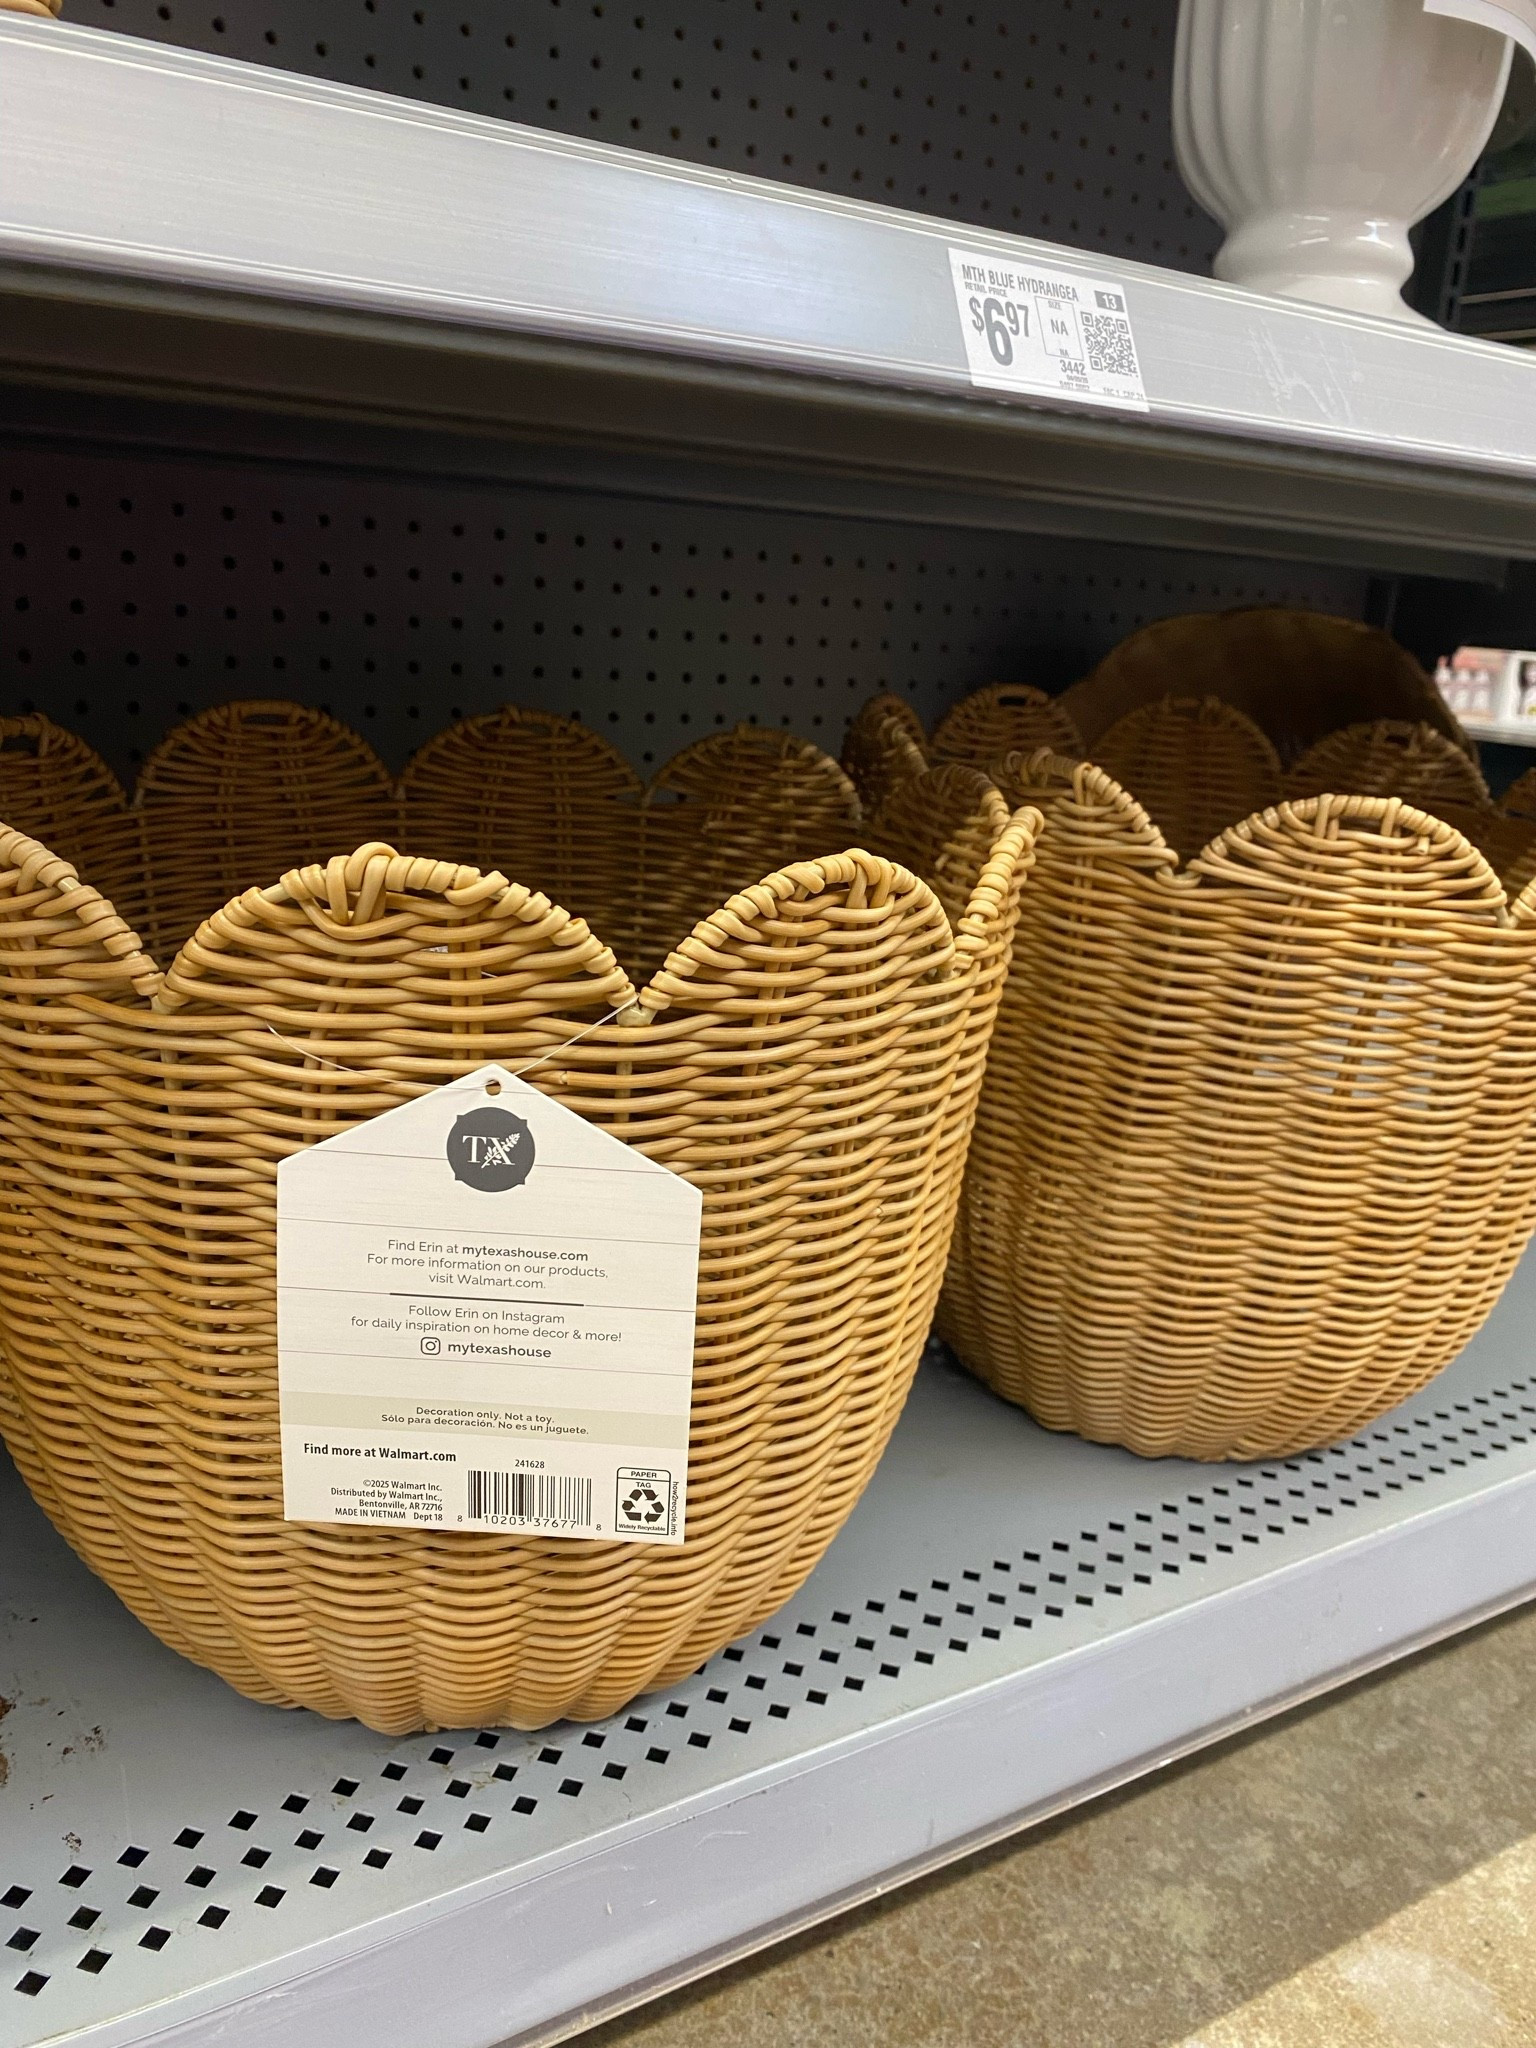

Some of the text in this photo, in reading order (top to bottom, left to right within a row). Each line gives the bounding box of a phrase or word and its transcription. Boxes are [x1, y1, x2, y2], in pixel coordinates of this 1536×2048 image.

[962, 264, 1079, 302] MTH BLUE HYDRANGEA
[965, 281, 1008, 298] RETAIL PRICE
[1048, 300, 1062, 311] SIZE
[1102, 294, 1117, 310] 13
[1050, 319, 1069, 336] NA
[1060, 348, 1070, 358] NA
[1060, 360, 1087, 376] 3442
[388, 1240, 589, 1262] Find Erin at mytexashouse.com
[367, 1254, 388, 1265] For
[391, 1257, 425, 1267] more
[428, 1257, 501, 1271] information
[505, 1264, 520, 1273] on
[524, 1265, 545, 1274] our
[429, 1273, 546, 1289] visit Walmart.com.
[409, 1306, 565, 1324] Follow Erin on Instagram
[351, 1317, 622, 1343] for daily inspiration on home decor & more!
[448, 1342, 552, 1358] mytexashouse
[416, 1407, 473, 1417] Decoration
[477, 1411, 502, 1420] only.
[505, 1412, 523, 1421] Not
[535, 1415, 555, 1424] toy.
[381, 1414, 405, 1423] Sólo
[407, 1417, 431, 1425] para
[434, 1417, 495, 1428] decoración.
[498, 1421, 513, 1430] No
[545, 1425, 589, 1435] juguete.
[304, 1443, 456, 1461] Find more at Walmart.com
[515, 1459, 545, 1469] 241628
[363, 1479, 442, 1492] ©2025 Walmart Inc.
[331, 1487, 443, 1502] Distributed by Walmart Inc.,
[359, 1499, 443, 1511] Bentonville, AR 72716
[671, 1481, 679, 1536] how2recycle.info
[335, 1508, 443, 1522] MADE IN VIETNAM Dept 18
[457, 1515, 602, 1531] 8 10203 37677 8
